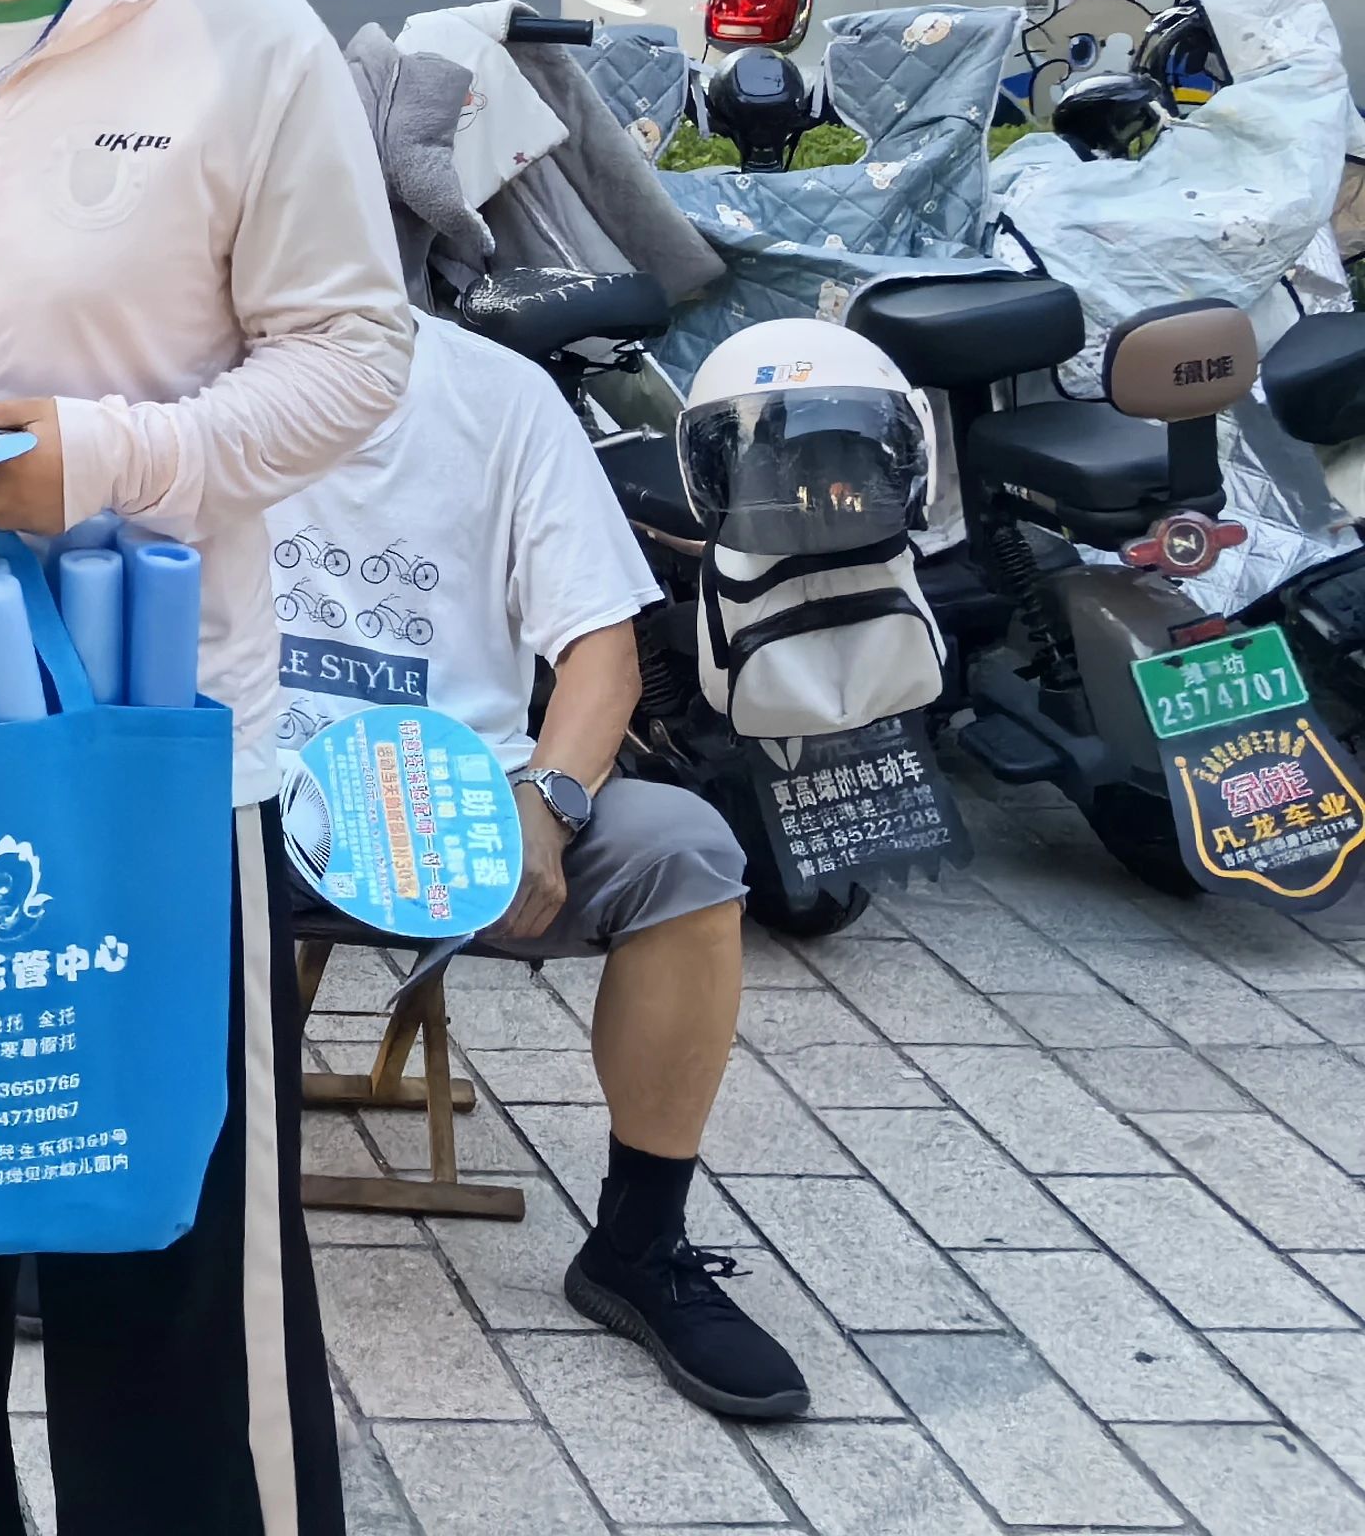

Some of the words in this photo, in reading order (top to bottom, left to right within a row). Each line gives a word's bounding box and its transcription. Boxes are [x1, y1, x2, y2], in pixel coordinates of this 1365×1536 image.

[320, 653, 421, 697] STYLE
[1158, 667, 1288, 727] 2574707
[771, 749, 924, 813] 更高端的电动车
[1212, 792, 1353, 854] 凡龙车业
